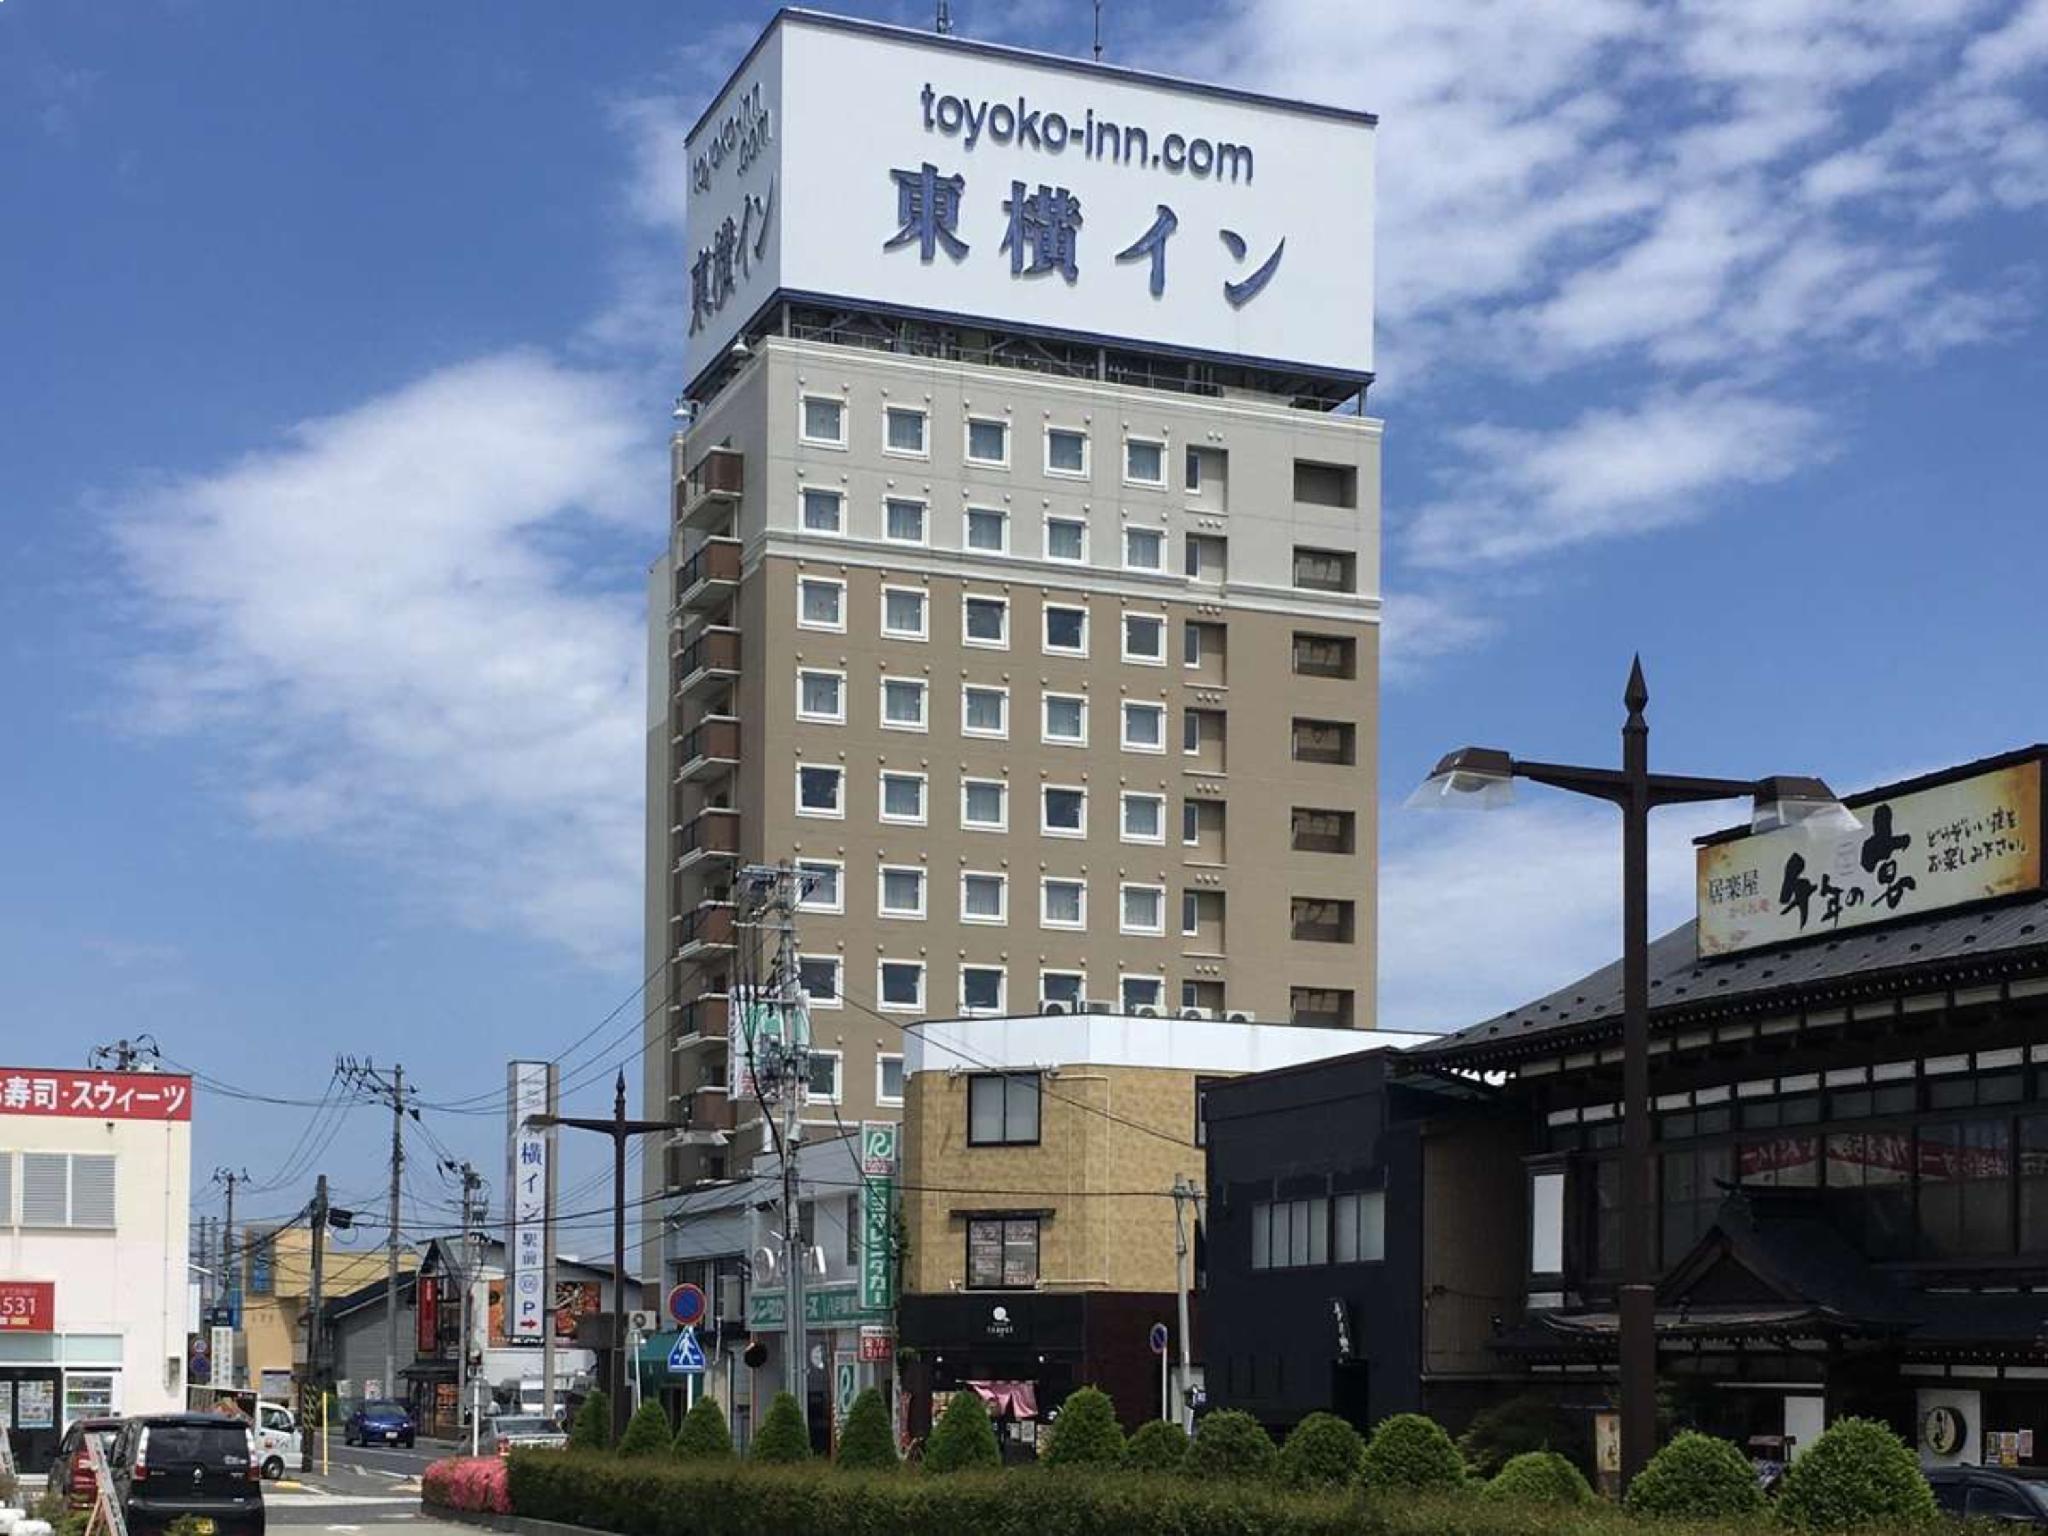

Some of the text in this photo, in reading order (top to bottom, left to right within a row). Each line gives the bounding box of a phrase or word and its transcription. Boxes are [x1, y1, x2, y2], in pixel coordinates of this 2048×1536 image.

[692, 81, 764, 194] toyoko-inn
[919, 82, 1253, 184] toyoko-inn.com
[689, 174, 774, 337] 東横イン
[884, 162, 1286, 308] 東横イン
[1779, 803, 1916, 932] 千年の宴
[0, 1076, 186, 1112] 寿司・スウィーツ
[523, 1301, 536, 1316] P
